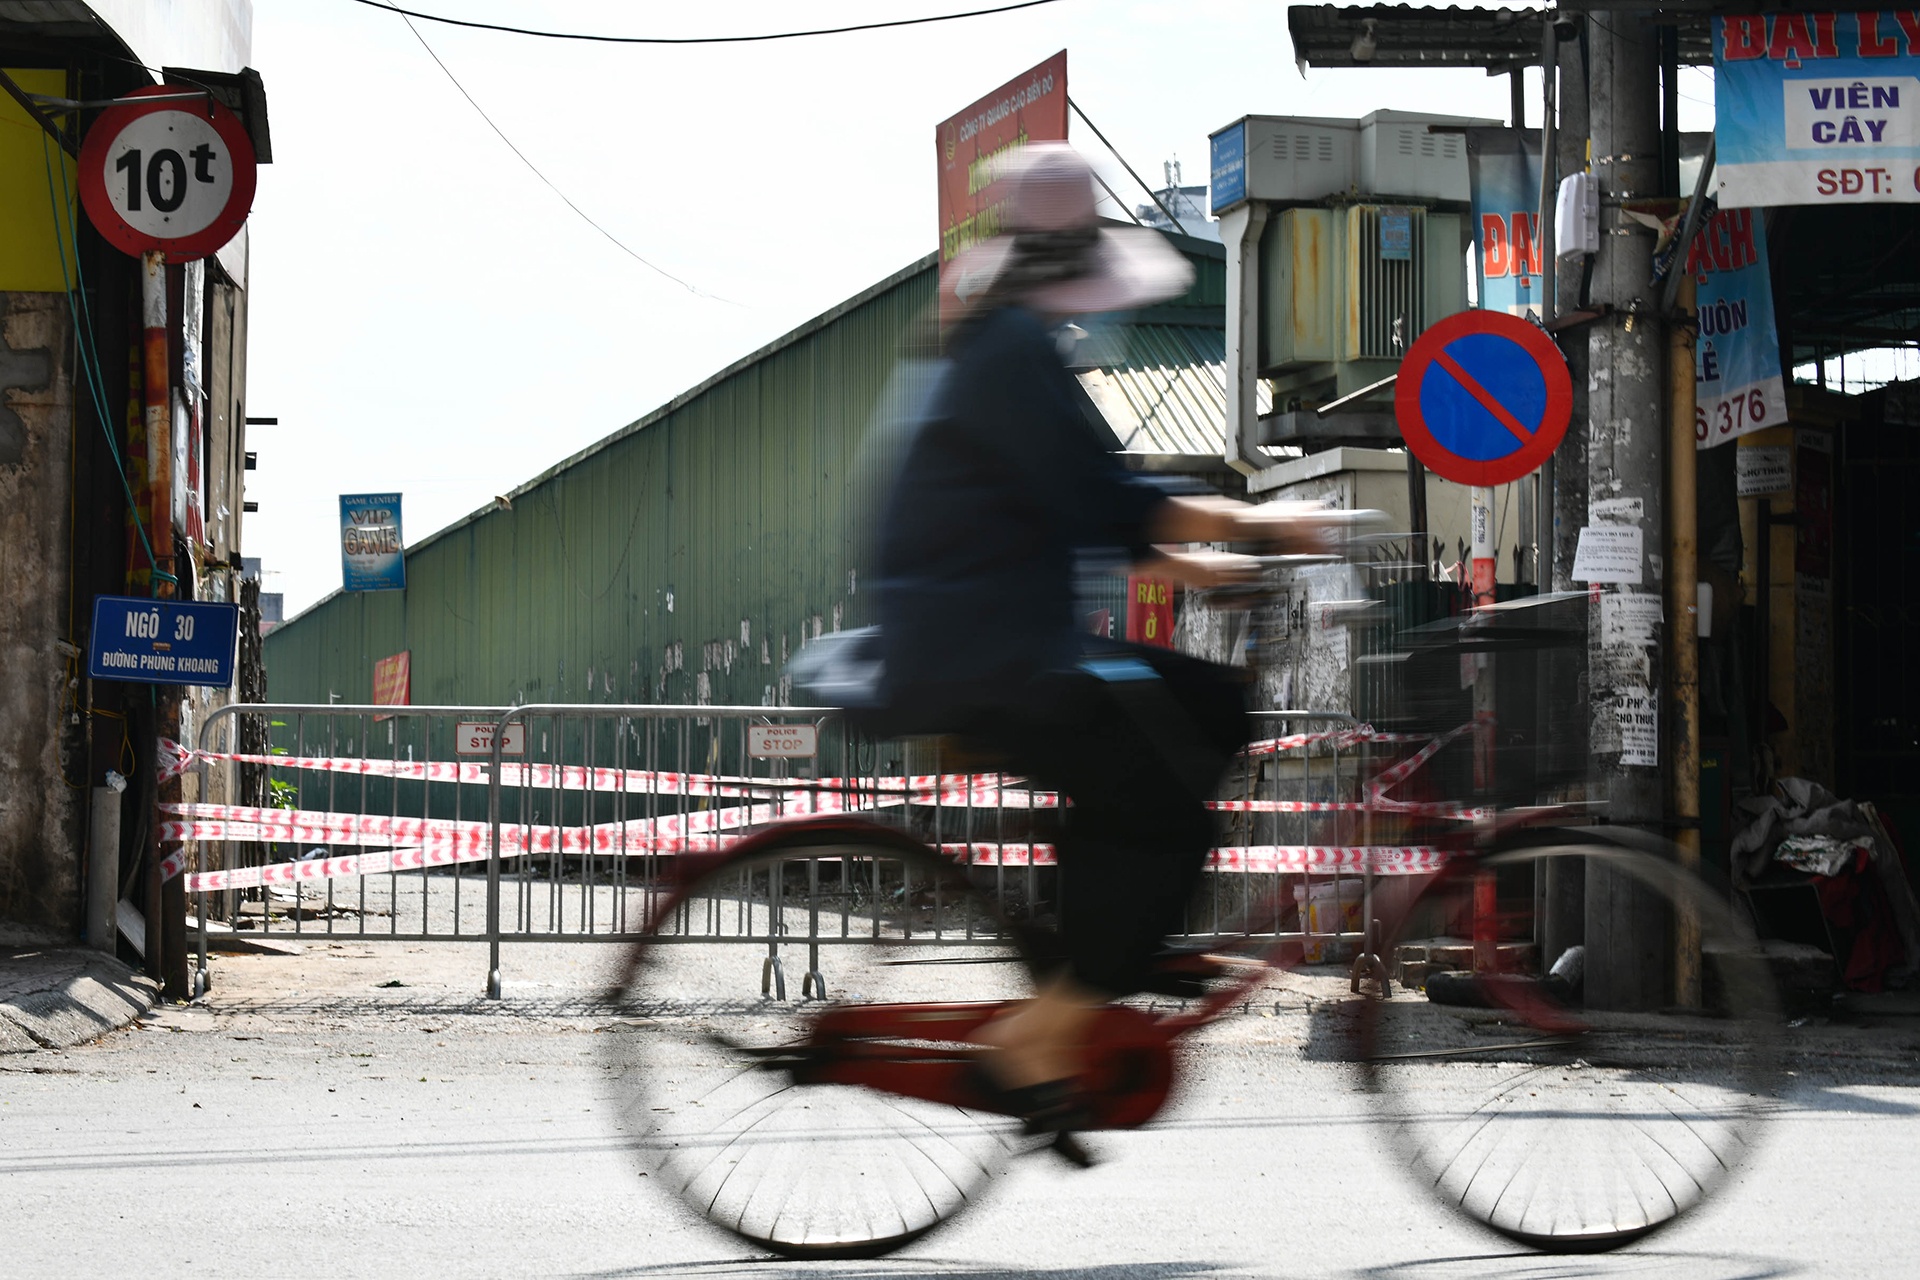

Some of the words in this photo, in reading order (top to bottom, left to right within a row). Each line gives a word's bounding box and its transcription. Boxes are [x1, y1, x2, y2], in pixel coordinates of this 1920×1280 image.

[1722, 11, 1839, 69] ĐẠI
[1808, 81, 1900, 110] VIÊN
[960, 118, 978, 142] CÔNG
[1811, 115, 1888, 144] CÂY
[116, 143, 217, 213] 10t
[1816, 167, 1893, 196] SĐT:
[1686, 207, 1758, 284] ẠCH
[1696, 340, 1720, 382] Ẻ
[1717, 388, 1767, 435] 376
[345, 497, 367, 505] GAME
[369, 496, 398, 505] CENTER
[348, 509, 393, 525] VIP
[344, 527, 399, 556] GAME
[125, 607, 160, 639] NGÕ
[174, 615, 195, 641] 30
[102, 648, 138, 669] ĐƯỜNG
[140, 651, 176, 672] PHÙNG
[177, 657, 219, 674] KHOANG
[475, 726, 496, 734] POLI
[763, 739, 803, 750] STOP
